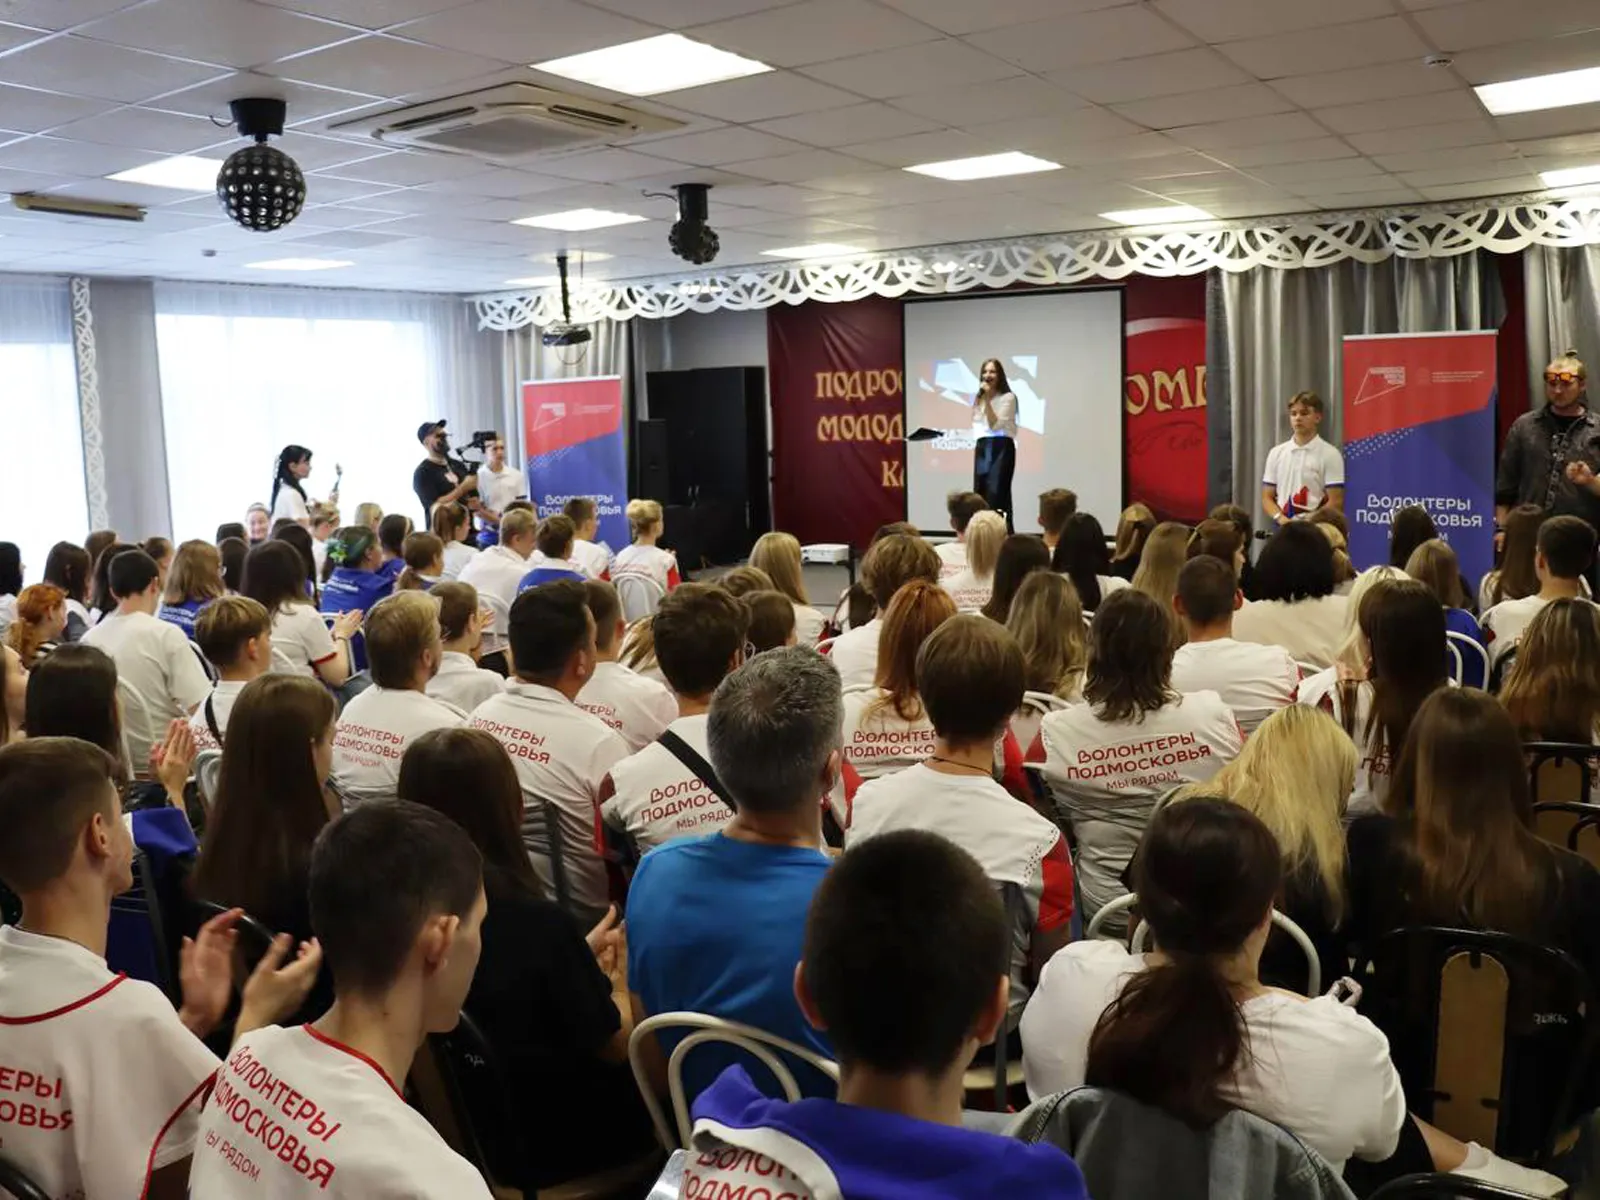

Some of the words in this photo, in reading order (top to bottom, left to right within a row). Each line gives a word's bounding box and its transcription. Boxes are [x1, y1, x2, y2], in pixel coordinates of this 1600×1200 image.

[816, 369, 902, 401] ПОДРО
[1067, 745, 1211, 780] ПОДМОСКОВЬЯ
[1077, 732, 1196, 764] ВОЛОНТЕРЫ
[650, 779, 708, 804] ВОЛО
[1131, 769, 1179, 787] РЯДОМ
[221, 1140, 261, 1182] РЯДОМ
